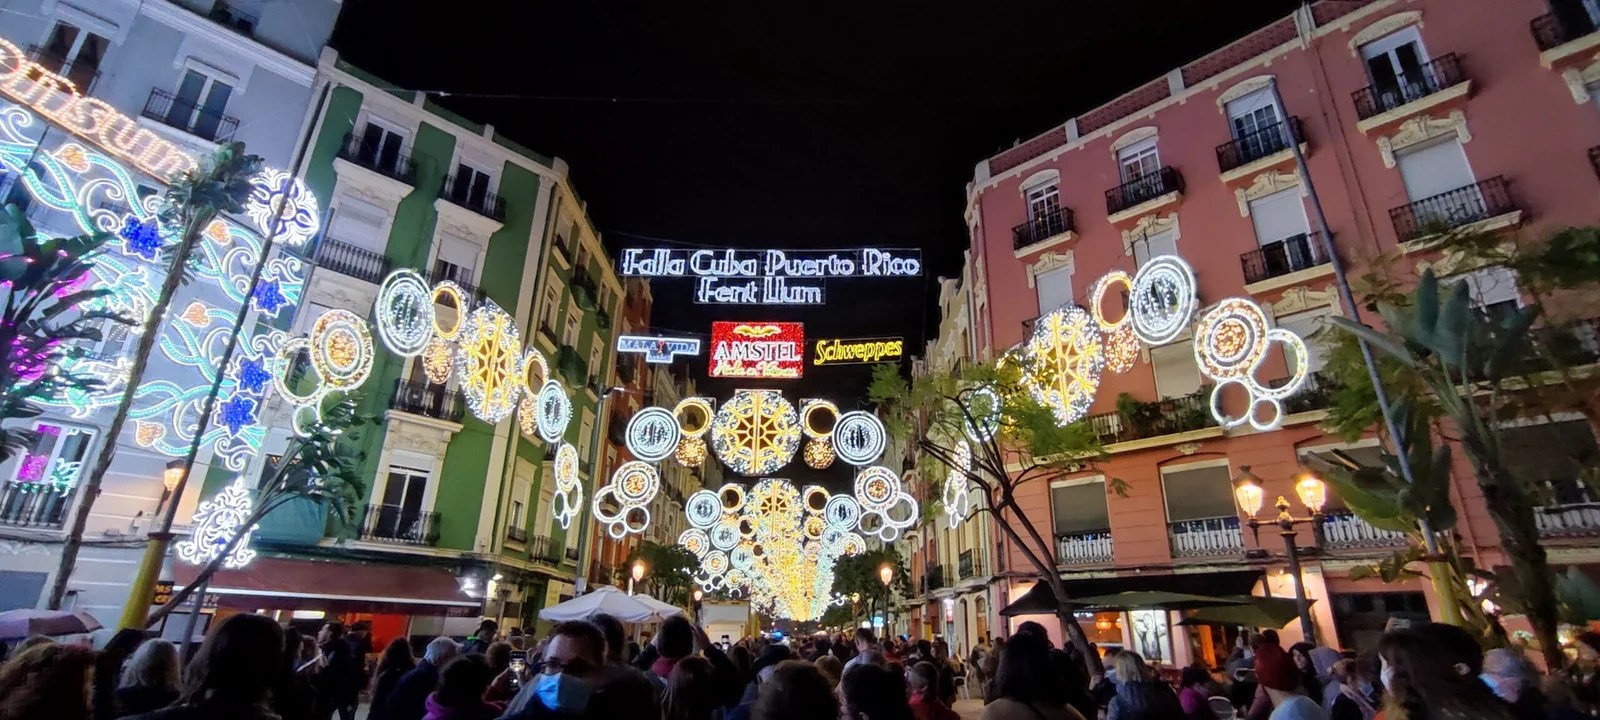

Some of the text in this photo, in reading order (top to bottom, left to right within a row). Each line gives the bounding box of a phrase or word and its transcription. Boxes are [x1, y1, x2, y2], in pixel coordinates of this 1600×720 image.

[623, 248, 920, 276] Falla Cuba Puerto Rico
[698, 276, 821, 303] Fent Llum
[620, 340, 697, 353] MALA VIDA
[713, 341, 801, 361] AMSTEL
[814, 339, 902, 366] Schweppes
